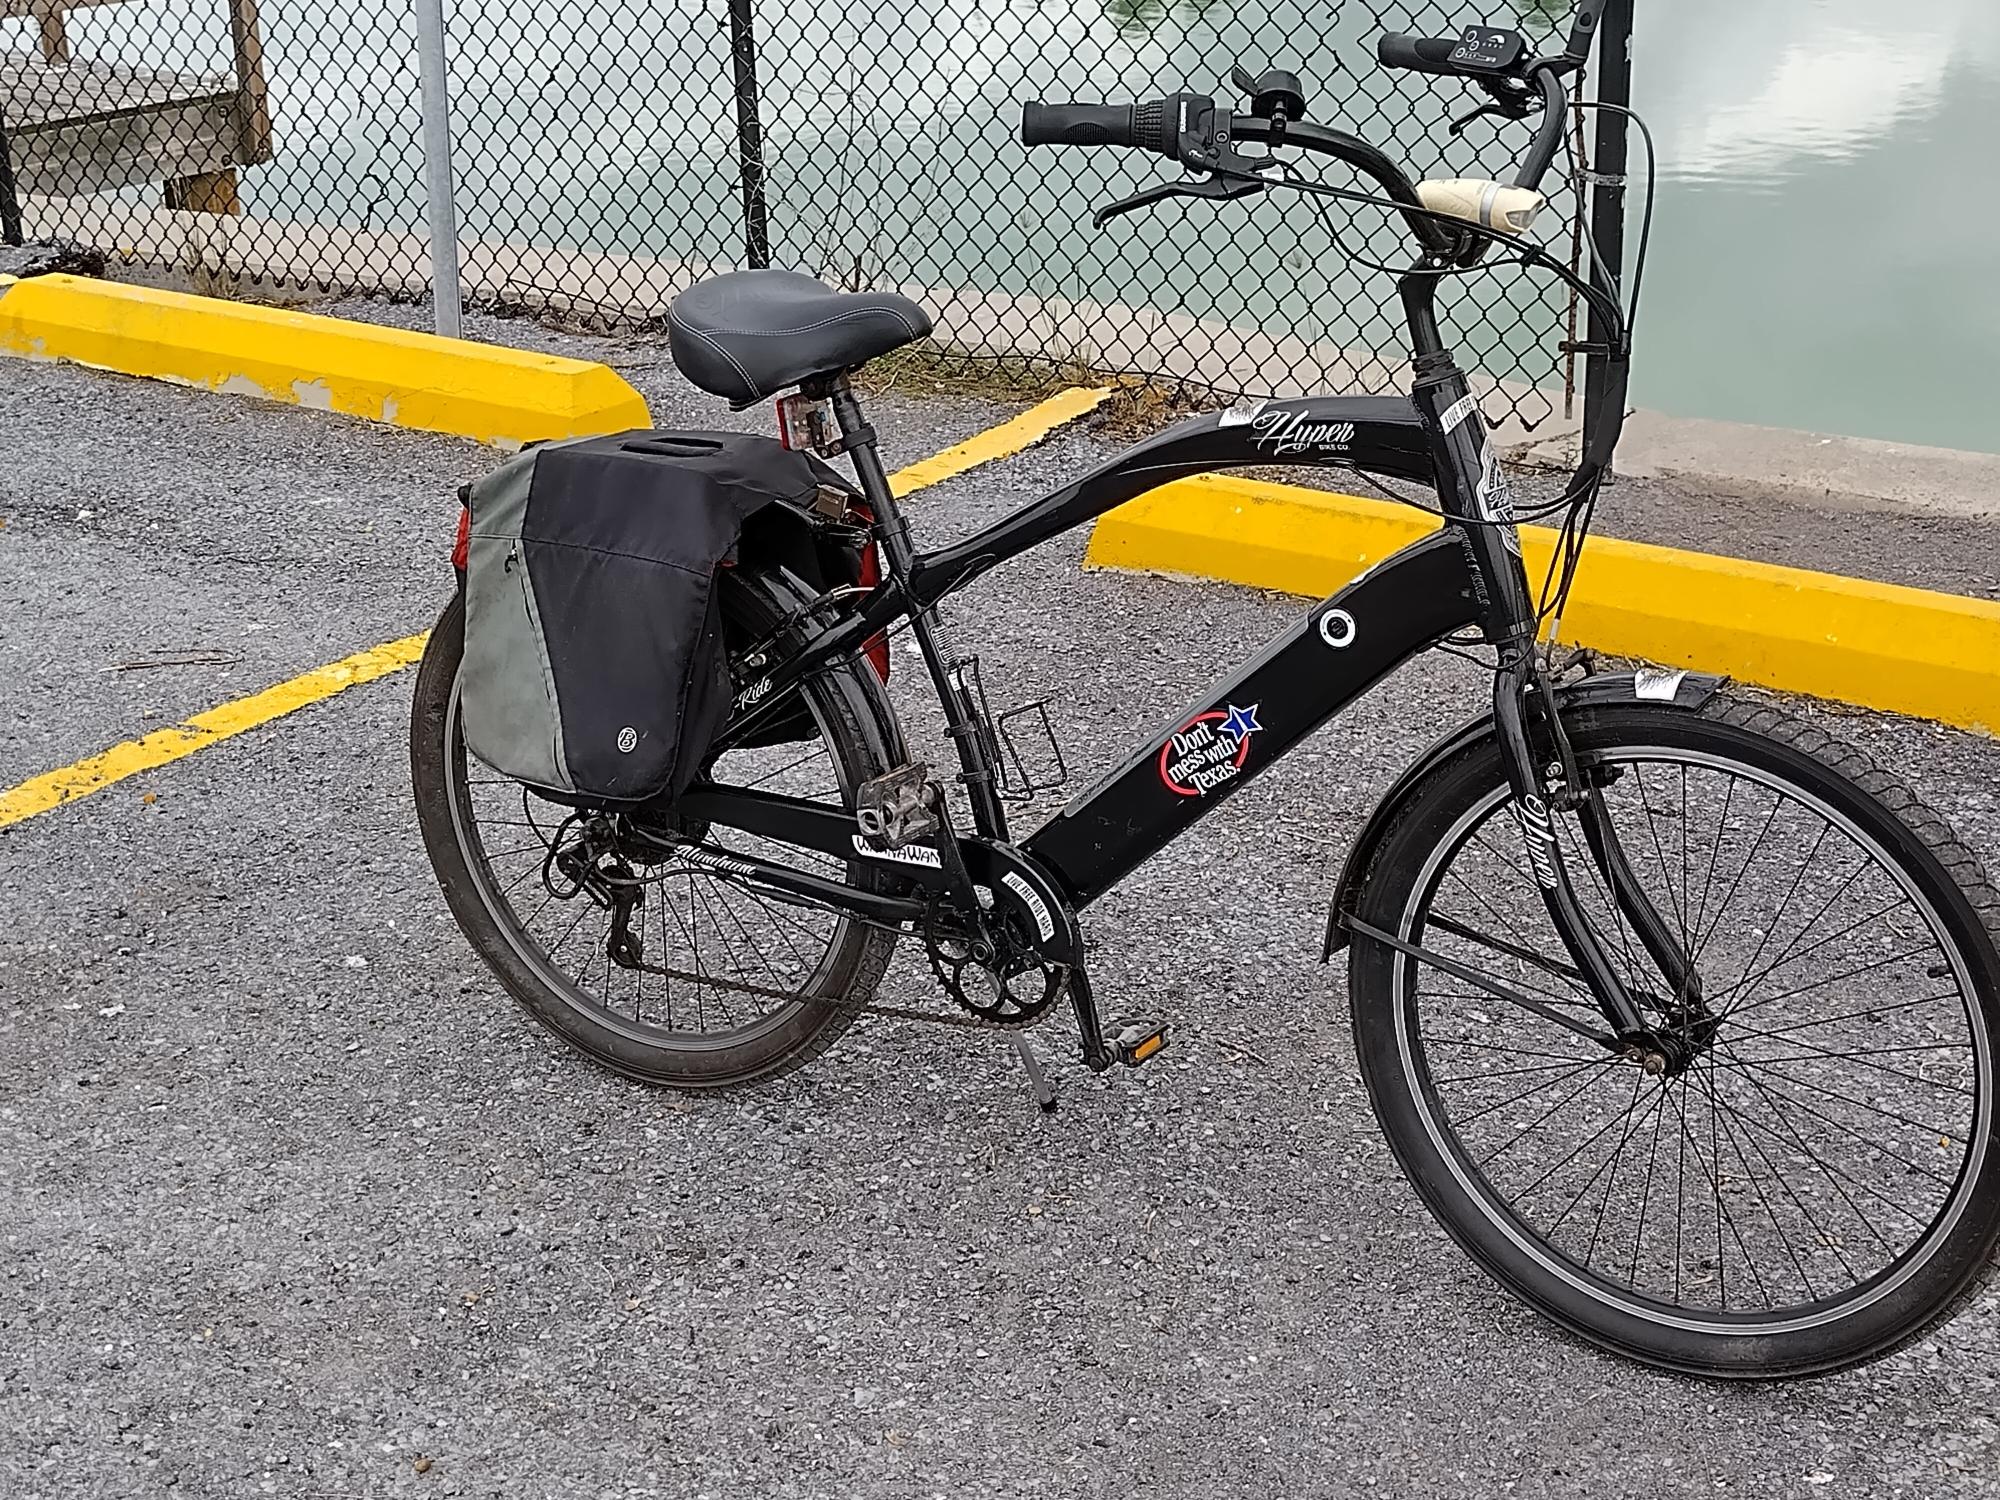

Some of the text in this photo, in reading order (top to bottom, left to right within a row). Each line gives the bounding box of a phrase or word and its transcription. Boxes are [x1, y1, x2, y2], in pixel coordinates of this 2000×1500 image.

[1250, 409, 1355, 457] Hyper
[1168, 750, 1206, 783] mess
[1203, 734, 1238, 764] with
[1171, 721, 1214, 757] Don't
[1515, 794, 1557, 889] Hyper
